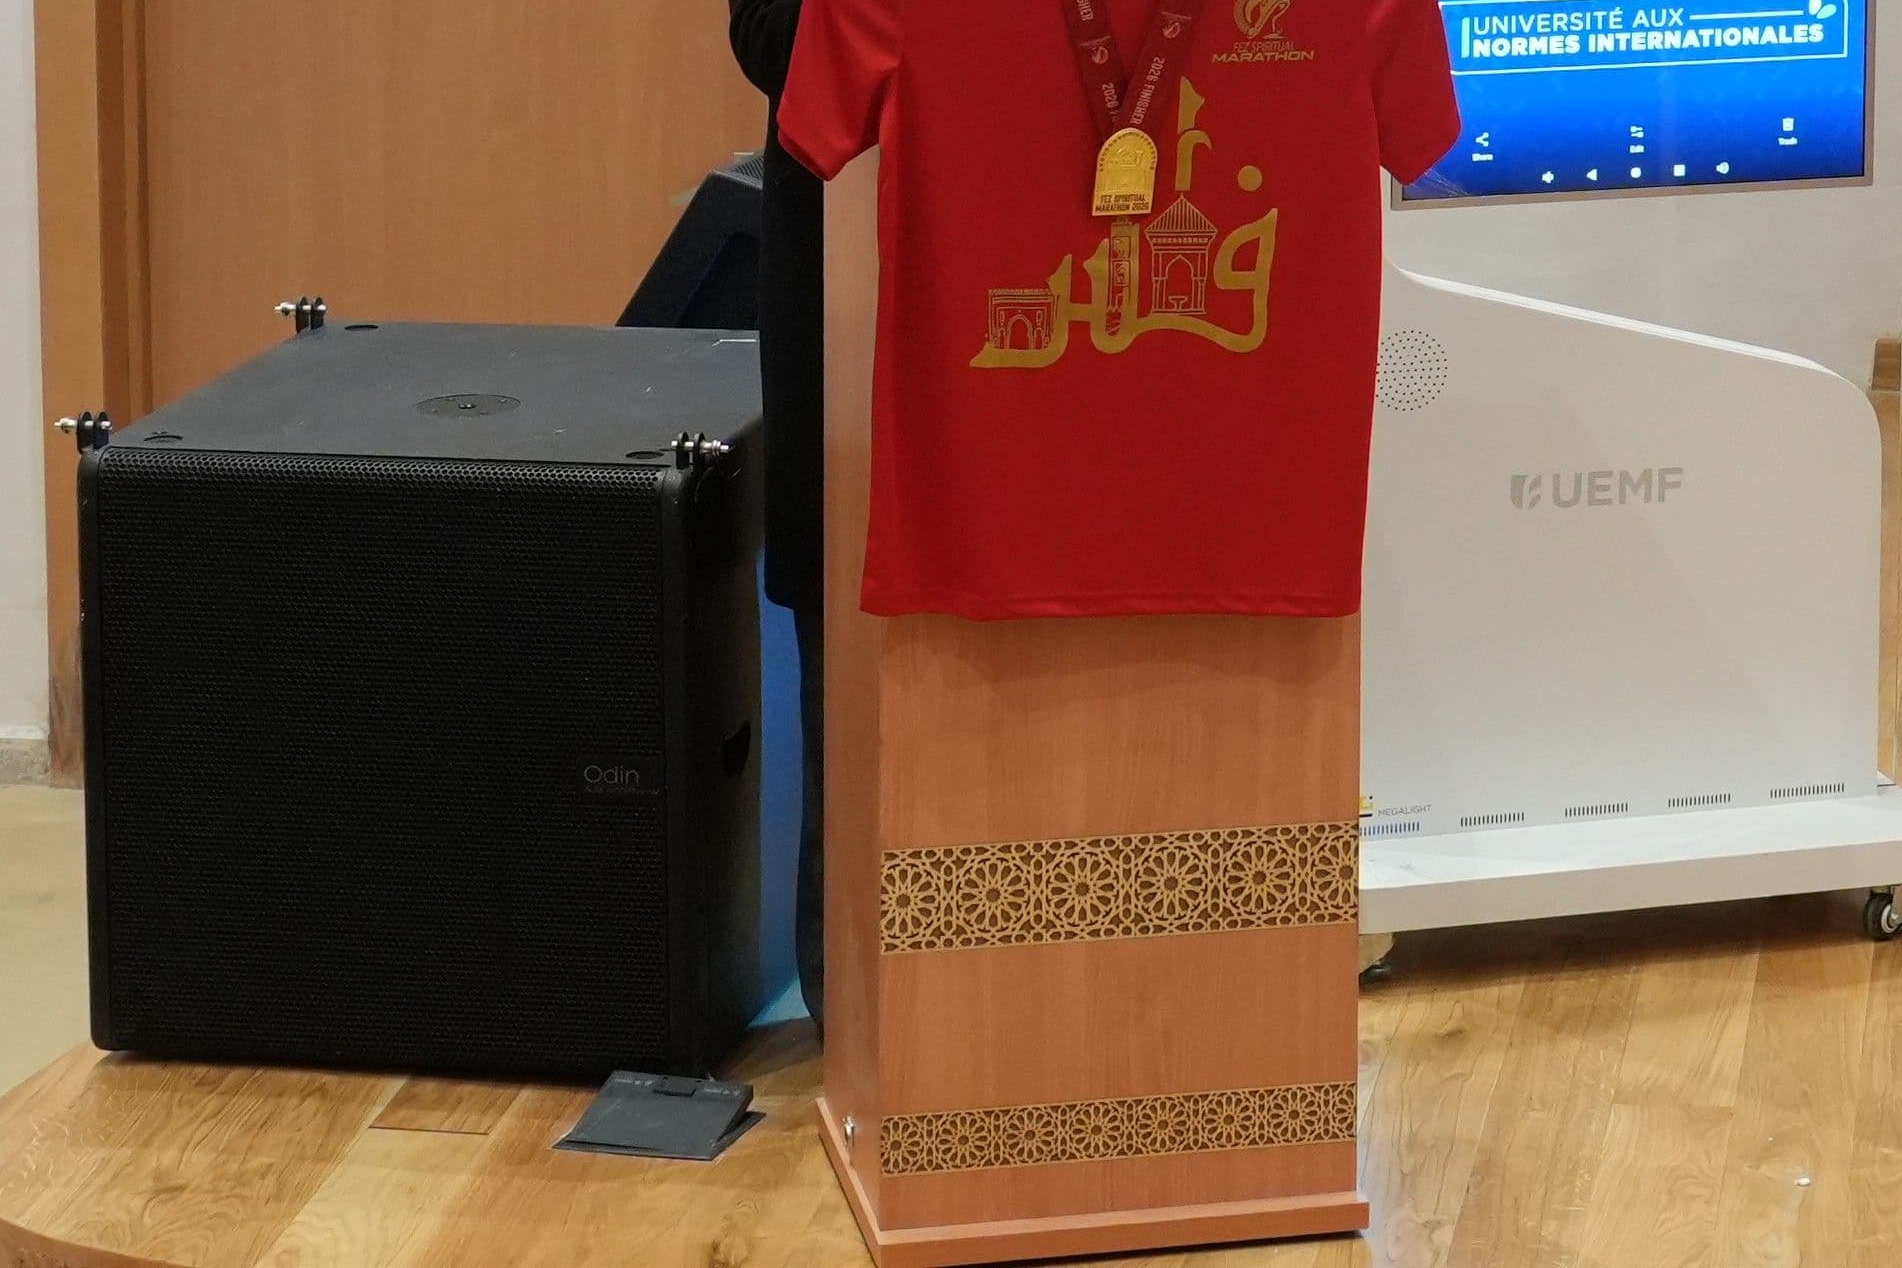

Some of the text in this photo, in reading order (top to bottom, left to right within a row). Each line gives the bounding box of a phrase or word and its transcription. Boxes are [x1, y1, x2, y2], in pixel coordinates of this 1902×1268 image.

[1473, 7, 1685, 35] UNIVERSITÉ AUX
[1473, 23, 1825, 58] NORMES INTERNATIONALES
[1212, 51, 1315, 63] MARATHON
[1130, 56, 1165, 125] 2026 FINISHER
[1552, 467, 1684, 508] UEMF
[584, 764, 640, 784] Odin
[1377, 804, 1432, 817] MEGALIGHT
